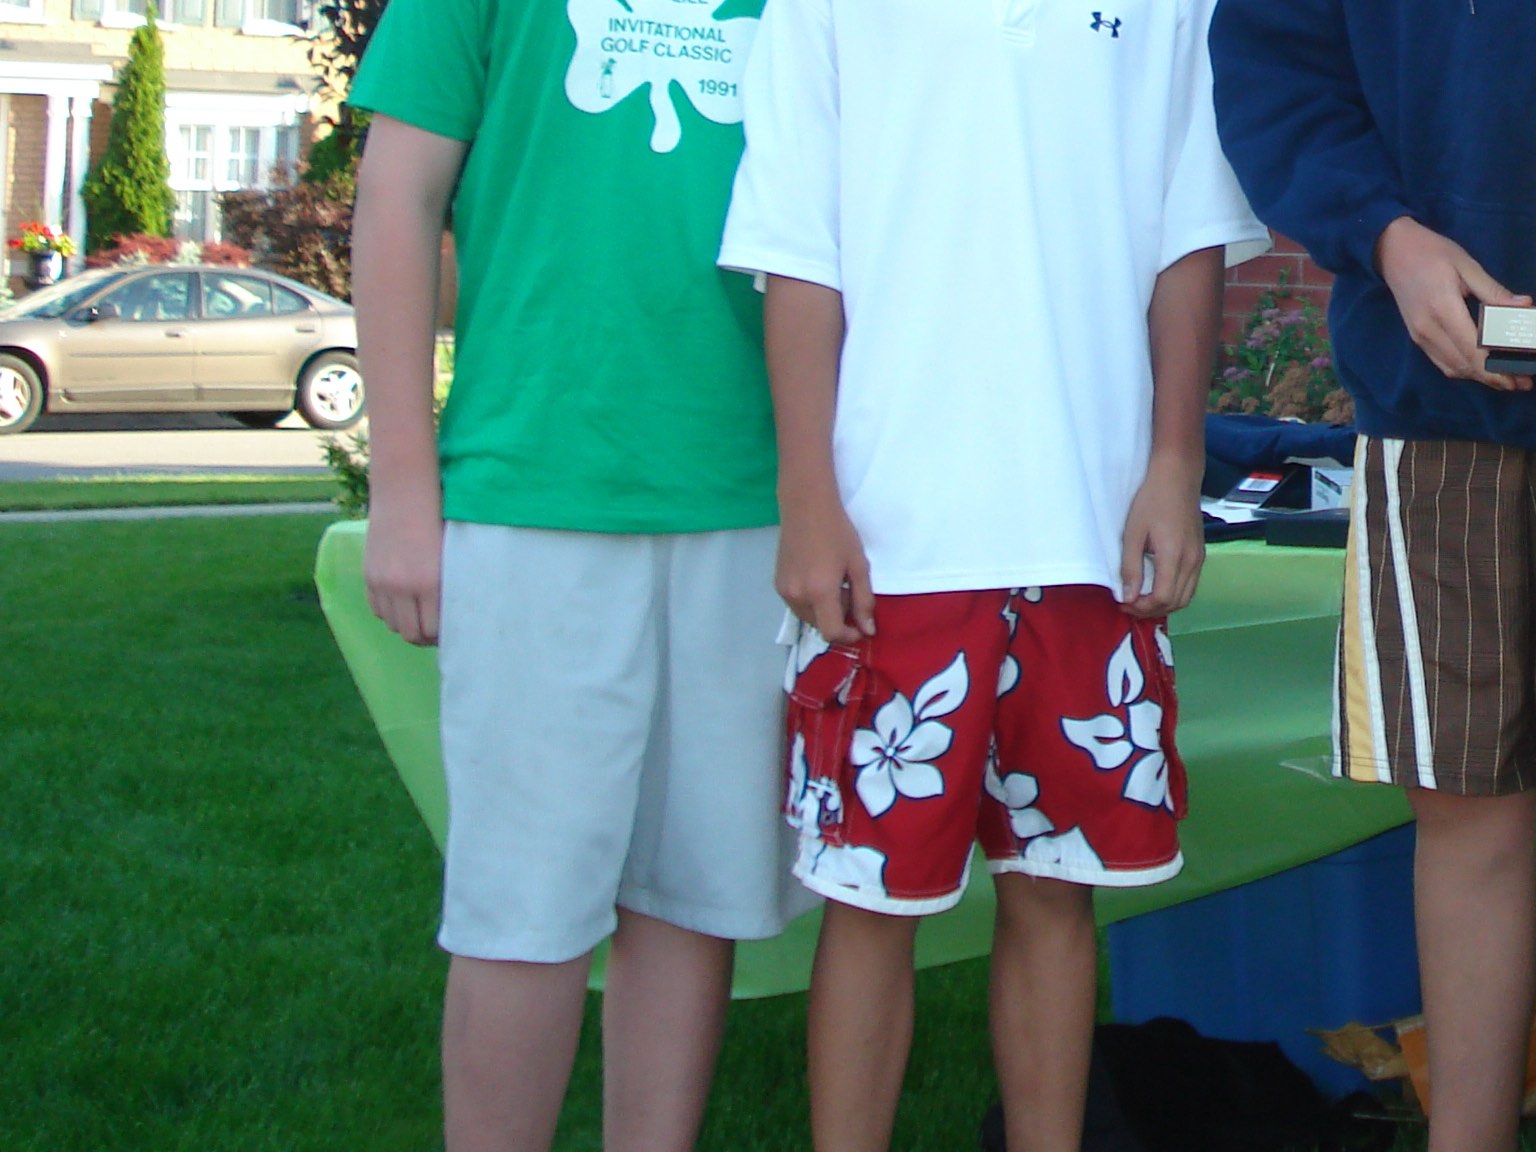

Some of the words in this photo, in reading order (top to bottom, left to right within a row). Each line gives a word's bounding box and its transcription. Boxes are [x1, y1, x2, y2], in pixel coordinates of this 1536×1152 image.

[608, 17, 727, 43] INVITATIONAL
[600, 36, 649, 54] GOLF
[653, 42, 733, 64] CLASSIC
[698, 78, 738, 97] 1991
